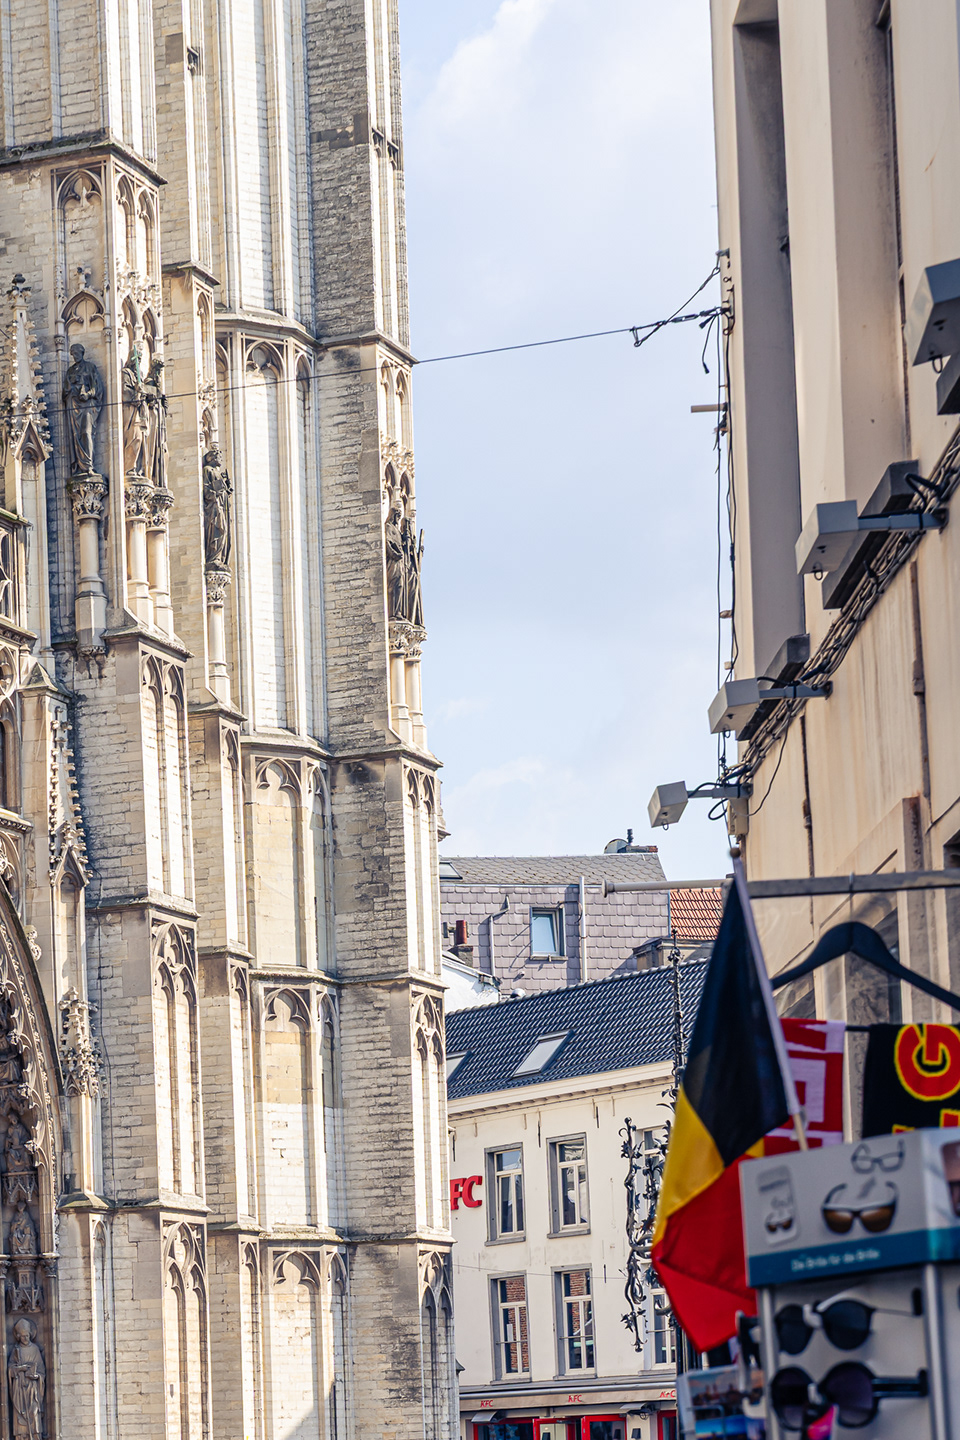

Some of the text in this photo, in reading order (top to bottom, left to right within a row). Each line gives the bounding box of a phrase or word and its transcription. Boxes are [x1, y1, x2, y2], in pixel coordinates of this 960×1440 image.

[450, 1175, 483, 1211] FC
[568, 1394, 582, 1403] KFC
[480, 1400, 493, 1408] KFC
